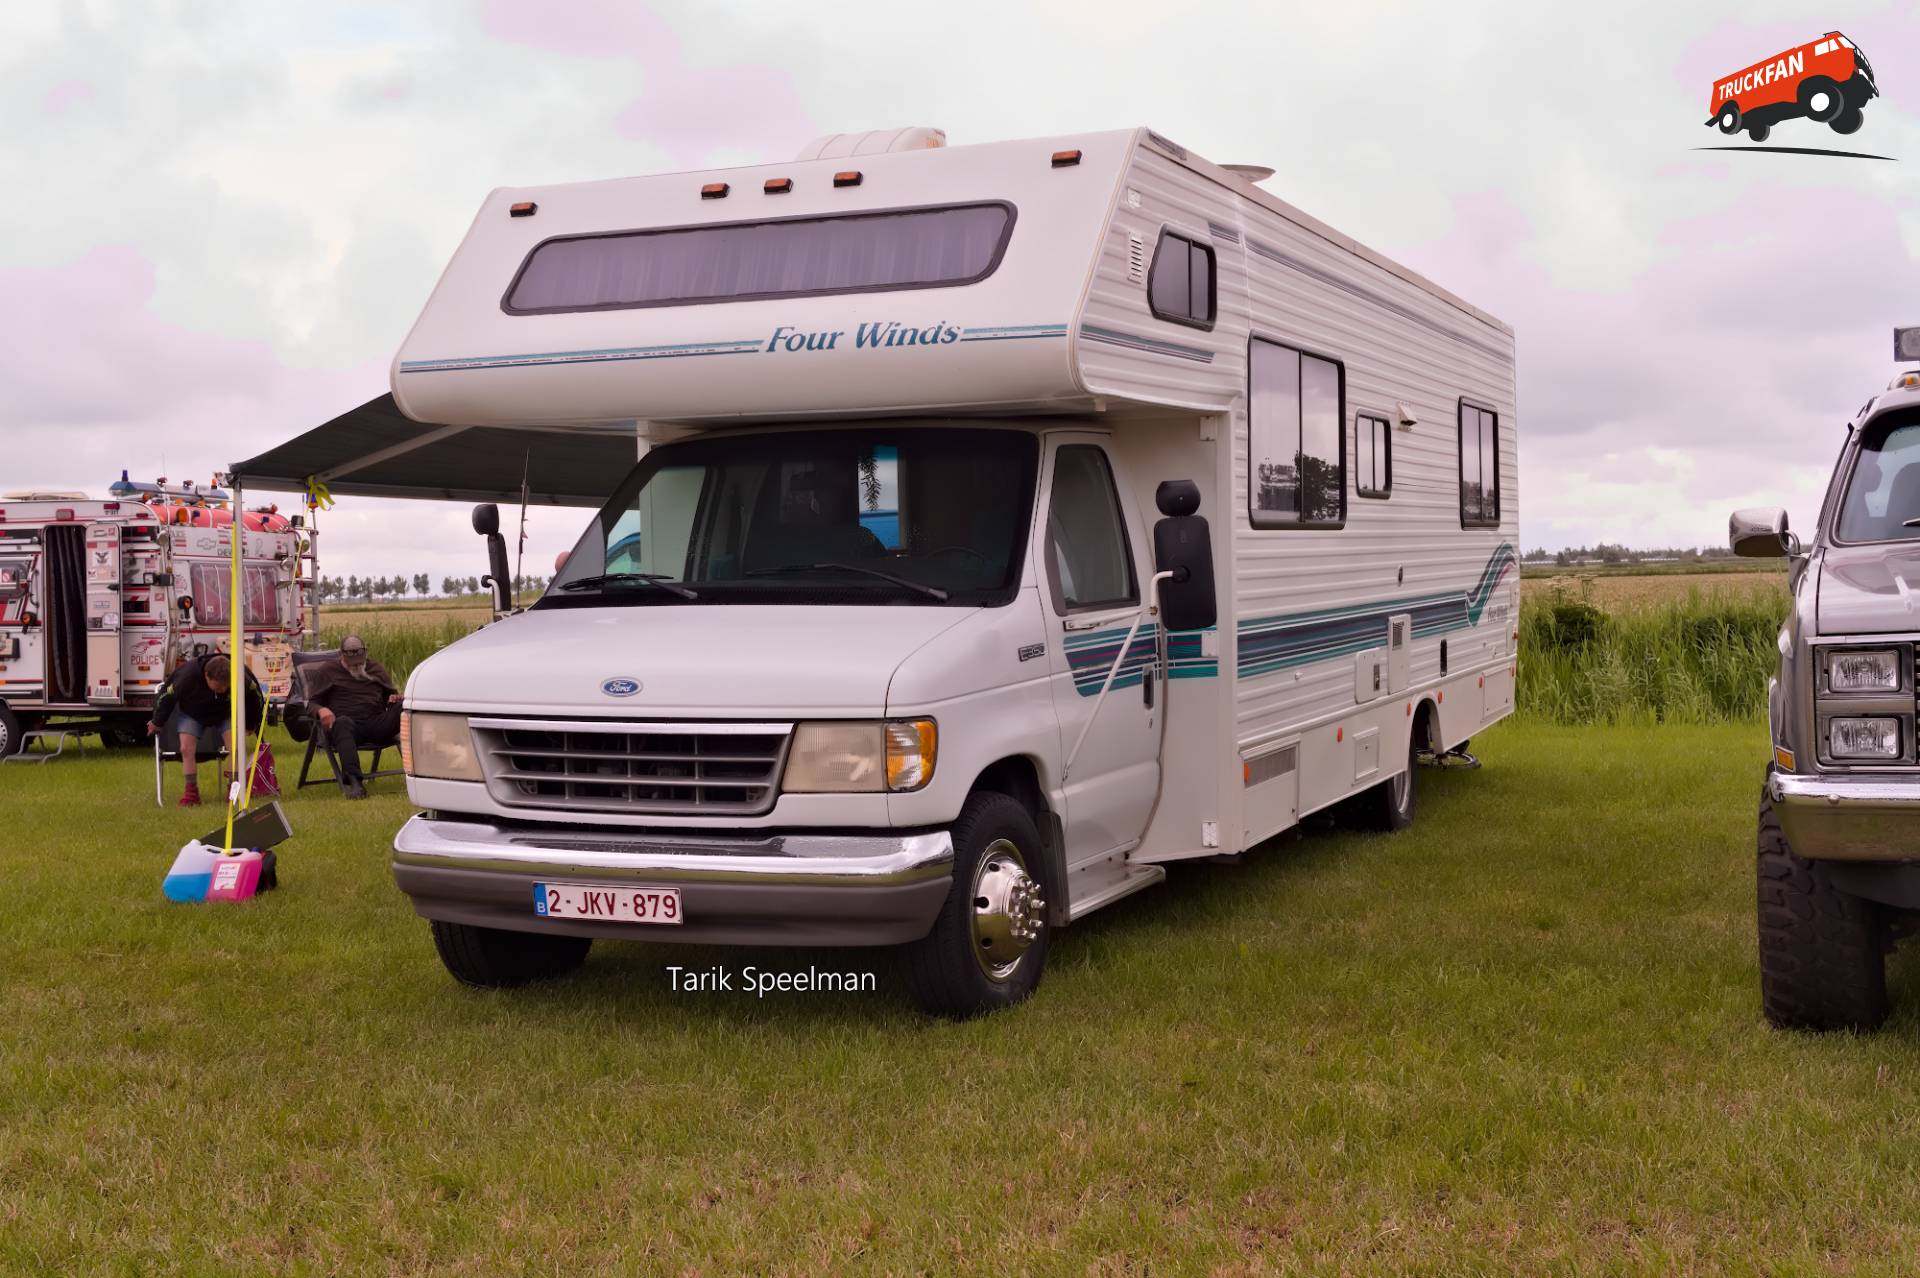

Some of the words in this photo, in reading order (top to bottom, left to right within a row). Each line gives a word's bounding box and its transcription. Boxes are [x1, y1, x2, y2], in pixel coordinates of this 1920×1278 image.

[766, 326, 845, 353] Four
[855, 320, 961, 349] Winds
[130, 655, 160, 665] POLICE
[536, 901, 546, 913] B
